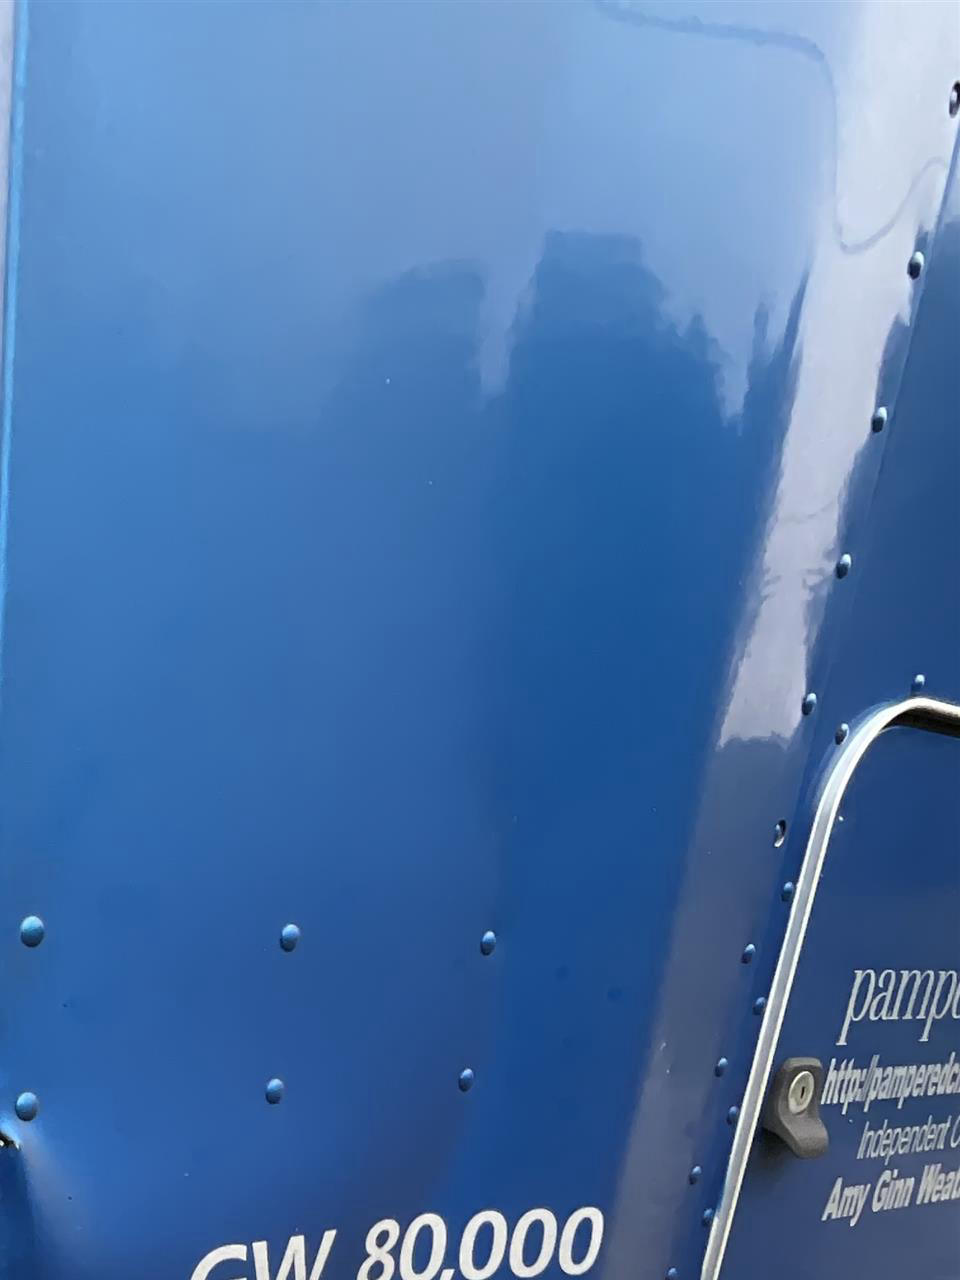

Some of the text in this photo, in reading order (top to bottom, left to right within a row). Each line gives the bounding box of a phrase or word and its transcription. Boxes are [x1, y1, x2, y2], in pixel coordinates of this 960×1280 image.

[857, 1115, 951, 1165] Independent
[821, 1177, 871, 1227] Amy
[873, 1169, 915, 1213] Ginn
